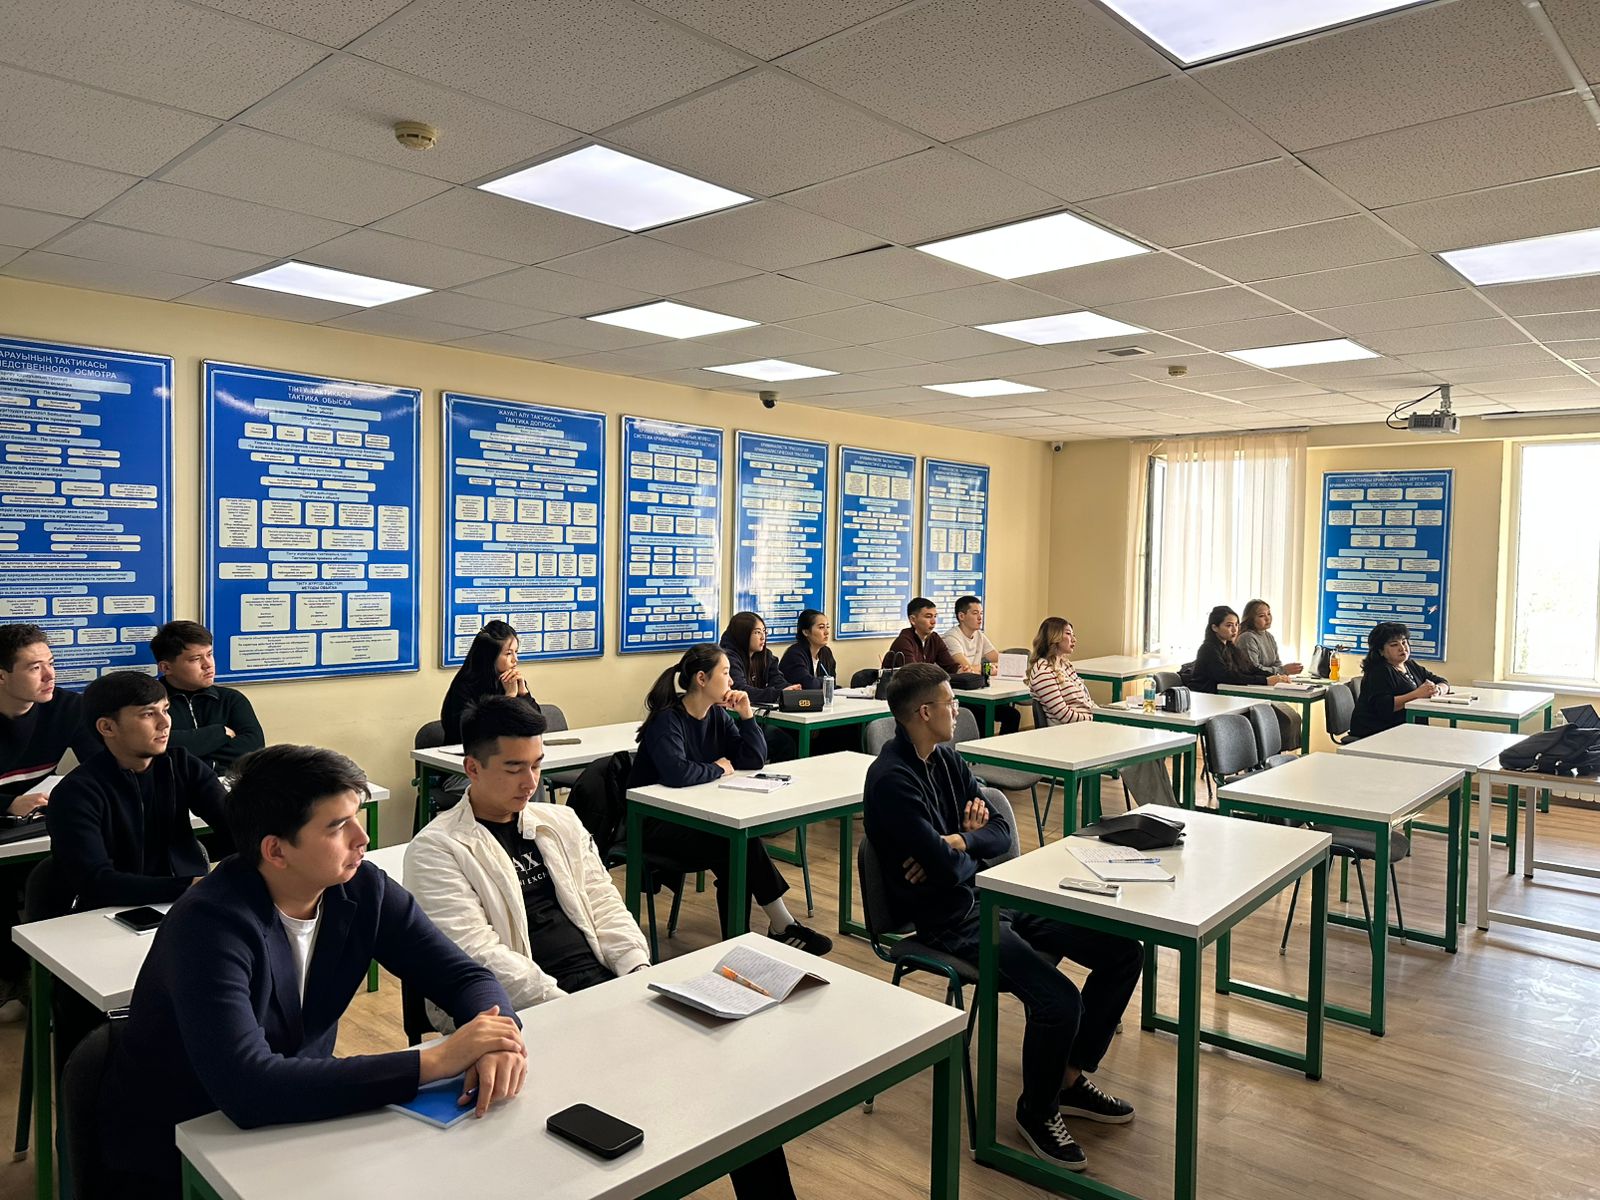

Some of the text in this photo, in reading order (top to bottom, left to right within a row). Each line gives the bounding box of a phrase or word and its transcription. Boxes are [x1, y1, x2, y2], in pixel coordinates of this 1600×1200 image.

[54, 356, 108, 369] ТАКТИКАСЫ
[0, 360, 70, 374] ЕДСТВЕННОГО
[75, 368, 117, 379] ОСМОТРА
[288, 393, 352, 406] ТАКТИКА ОБЫСКА
[505, 417, 529, 426] ТАКТИКА
